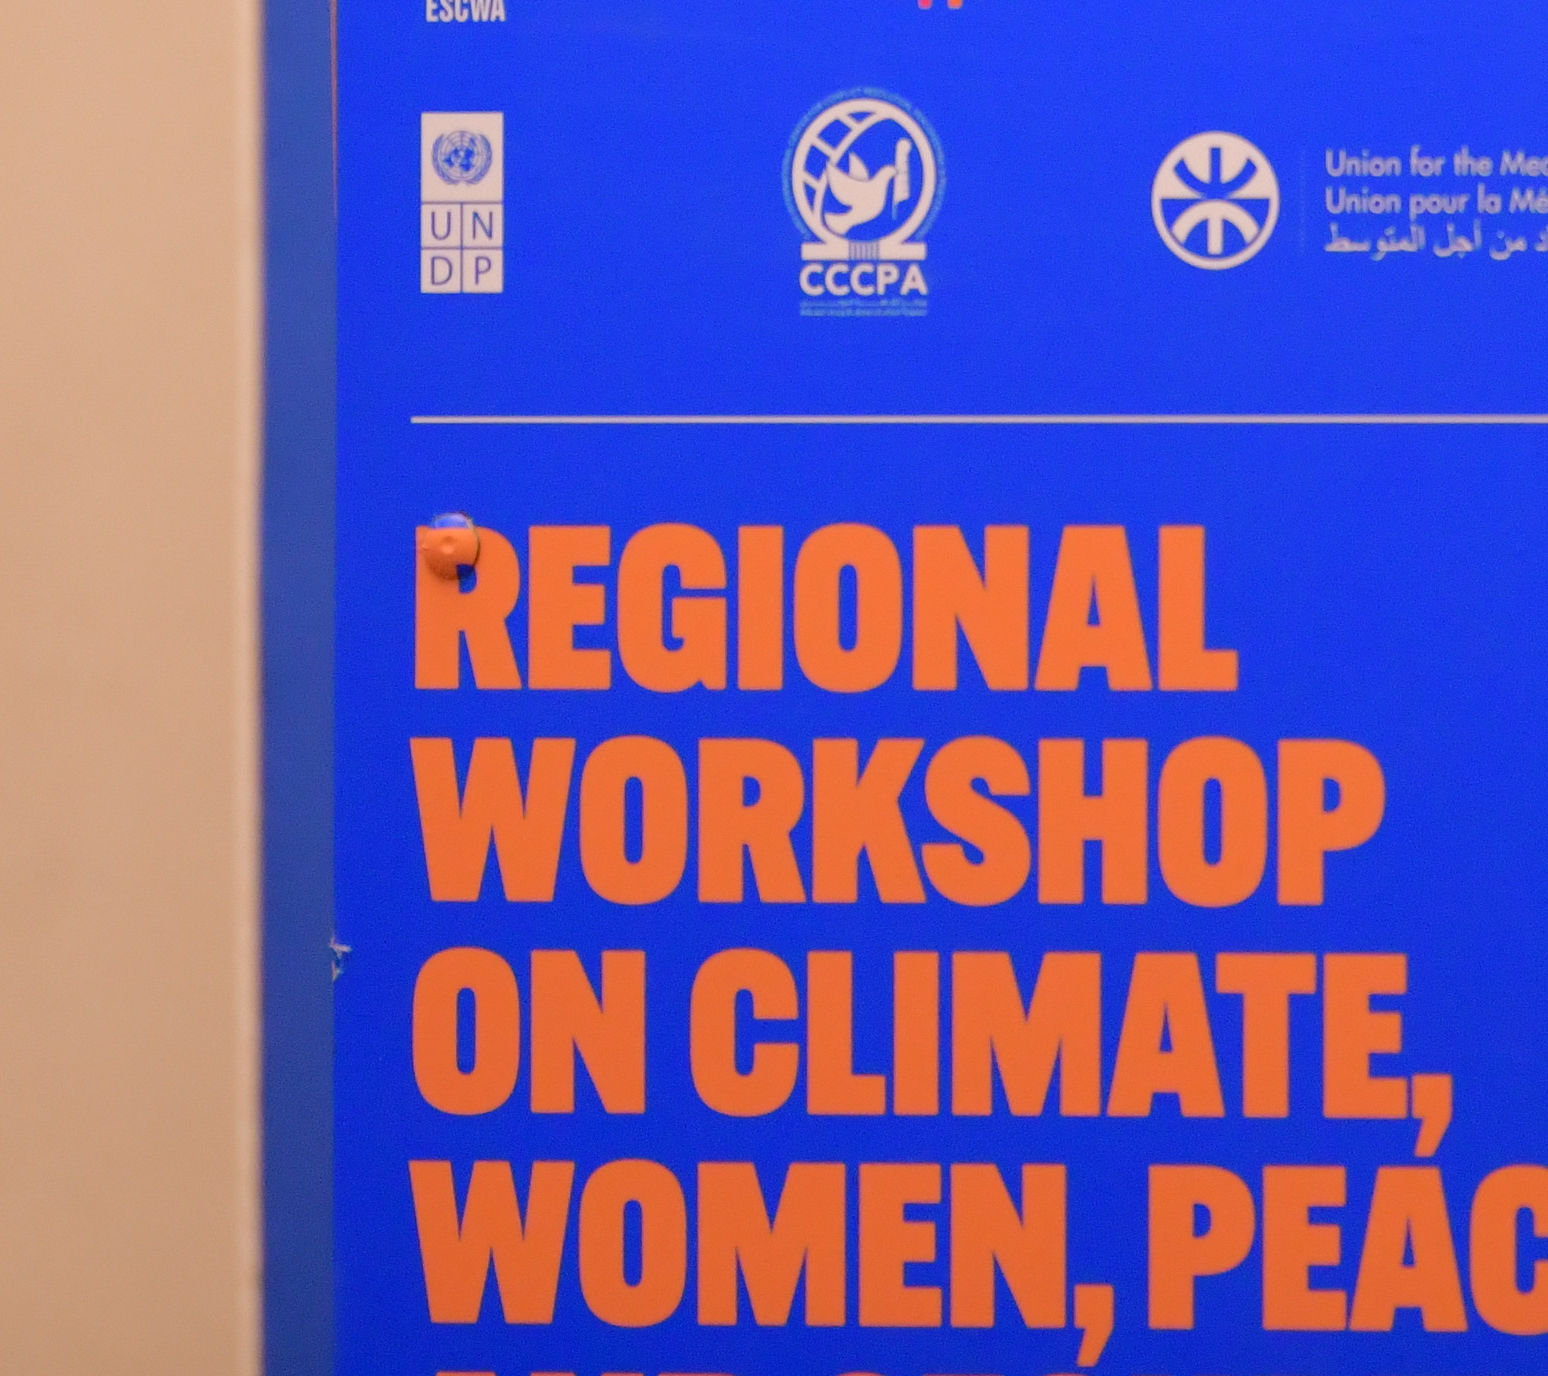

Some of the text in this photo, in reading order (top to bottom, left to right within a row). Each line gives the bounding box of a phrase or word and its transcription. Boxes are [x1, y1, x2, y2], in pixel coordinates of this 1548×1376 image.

[1326, 151, 1401, 176] Union
[1410, 146, 1444, 176] for
[1454, 148, 1492, 176] the
[1326, 188, 1401, 214] Union
[1410, 192, 1469, 221] pour
[1478, 184, 1501, 213] la
[801, 264, 926, 295] CCCPA
[1490, 230, 1527, 260] من
[417, 524, 1237, 692] REGIONAL
[412, 736, 1384, 906] WORKSHOP
[414, 948, 1452, 1156] ON CLIMATE,
[411, 1160, 1113, 1366] WOMEN,
